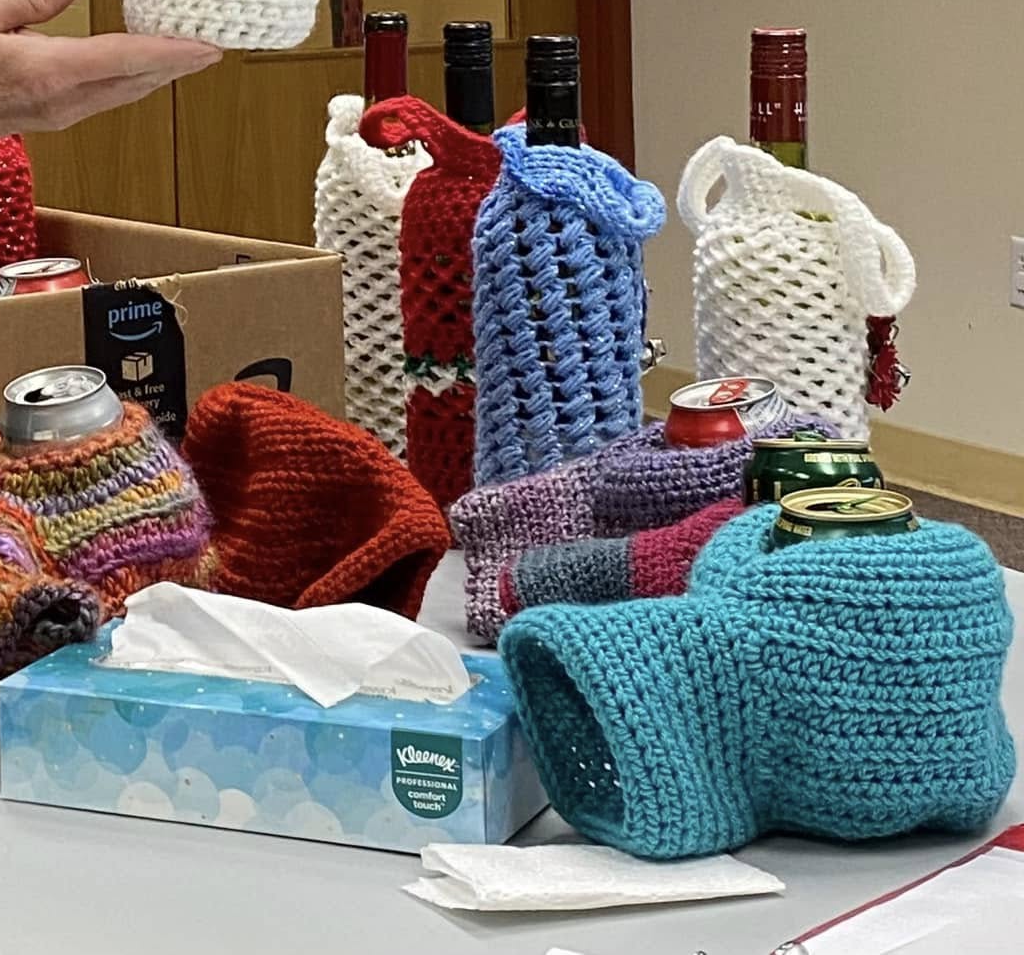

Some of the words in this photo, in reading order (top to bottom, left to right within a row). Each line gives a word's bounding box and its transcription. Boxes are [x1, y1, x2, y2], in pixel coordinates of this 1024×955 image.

[108, 301, 163, 329] prime
[134, 386, 143, 397] &
[144, 383, 166, 395] free
[396, 744, 457, 773] Kleenex
[396, 777, 457, 791] PROFESSIONAL
[408, 791, 446, 802] comfort
